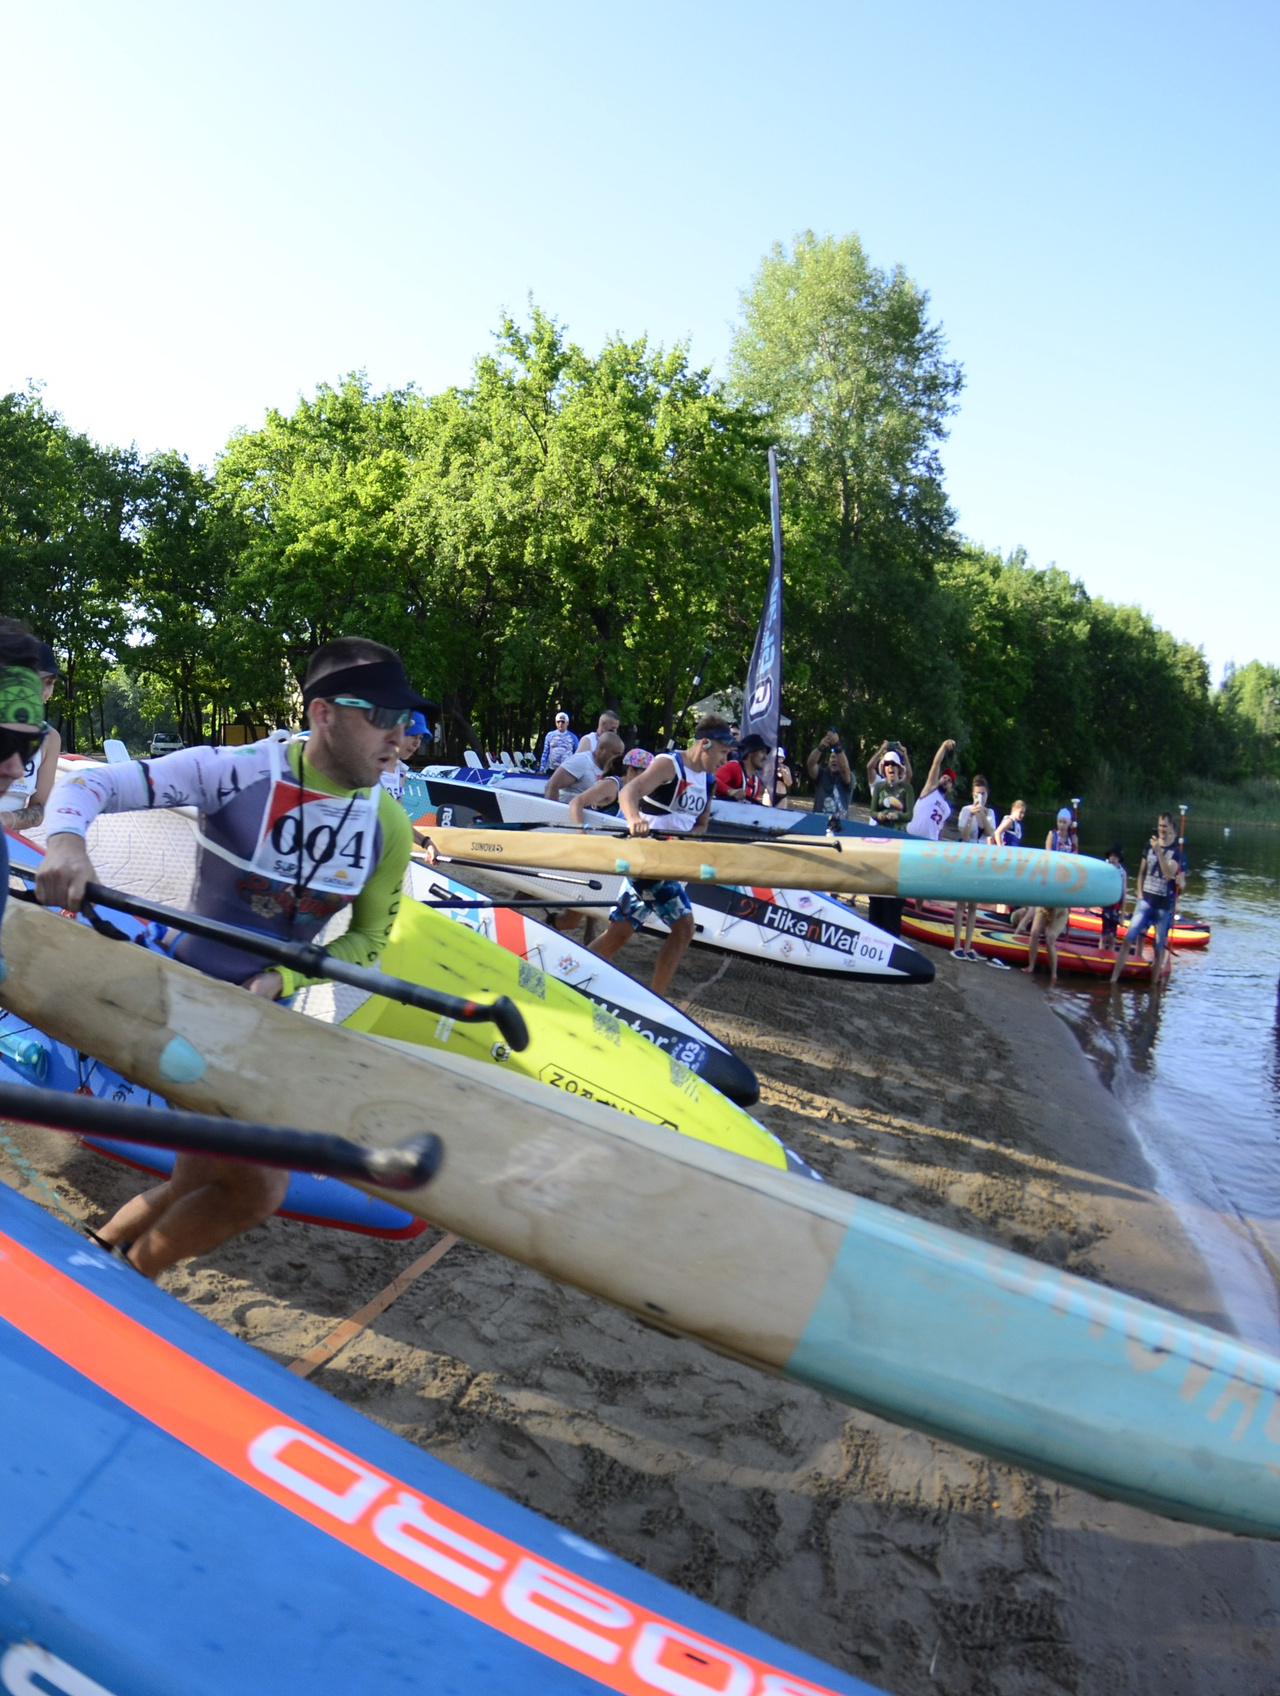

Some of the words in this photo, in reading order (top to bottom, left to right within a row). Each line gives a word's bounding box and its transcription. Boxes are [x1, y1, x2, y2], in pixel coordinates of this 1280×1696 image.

[678, 792, 705, 812] 020
[271, 814, 366, 869] 004
[920, 840, 1051, 886] SUNOVA
[860, 944, 884, 961] 100
